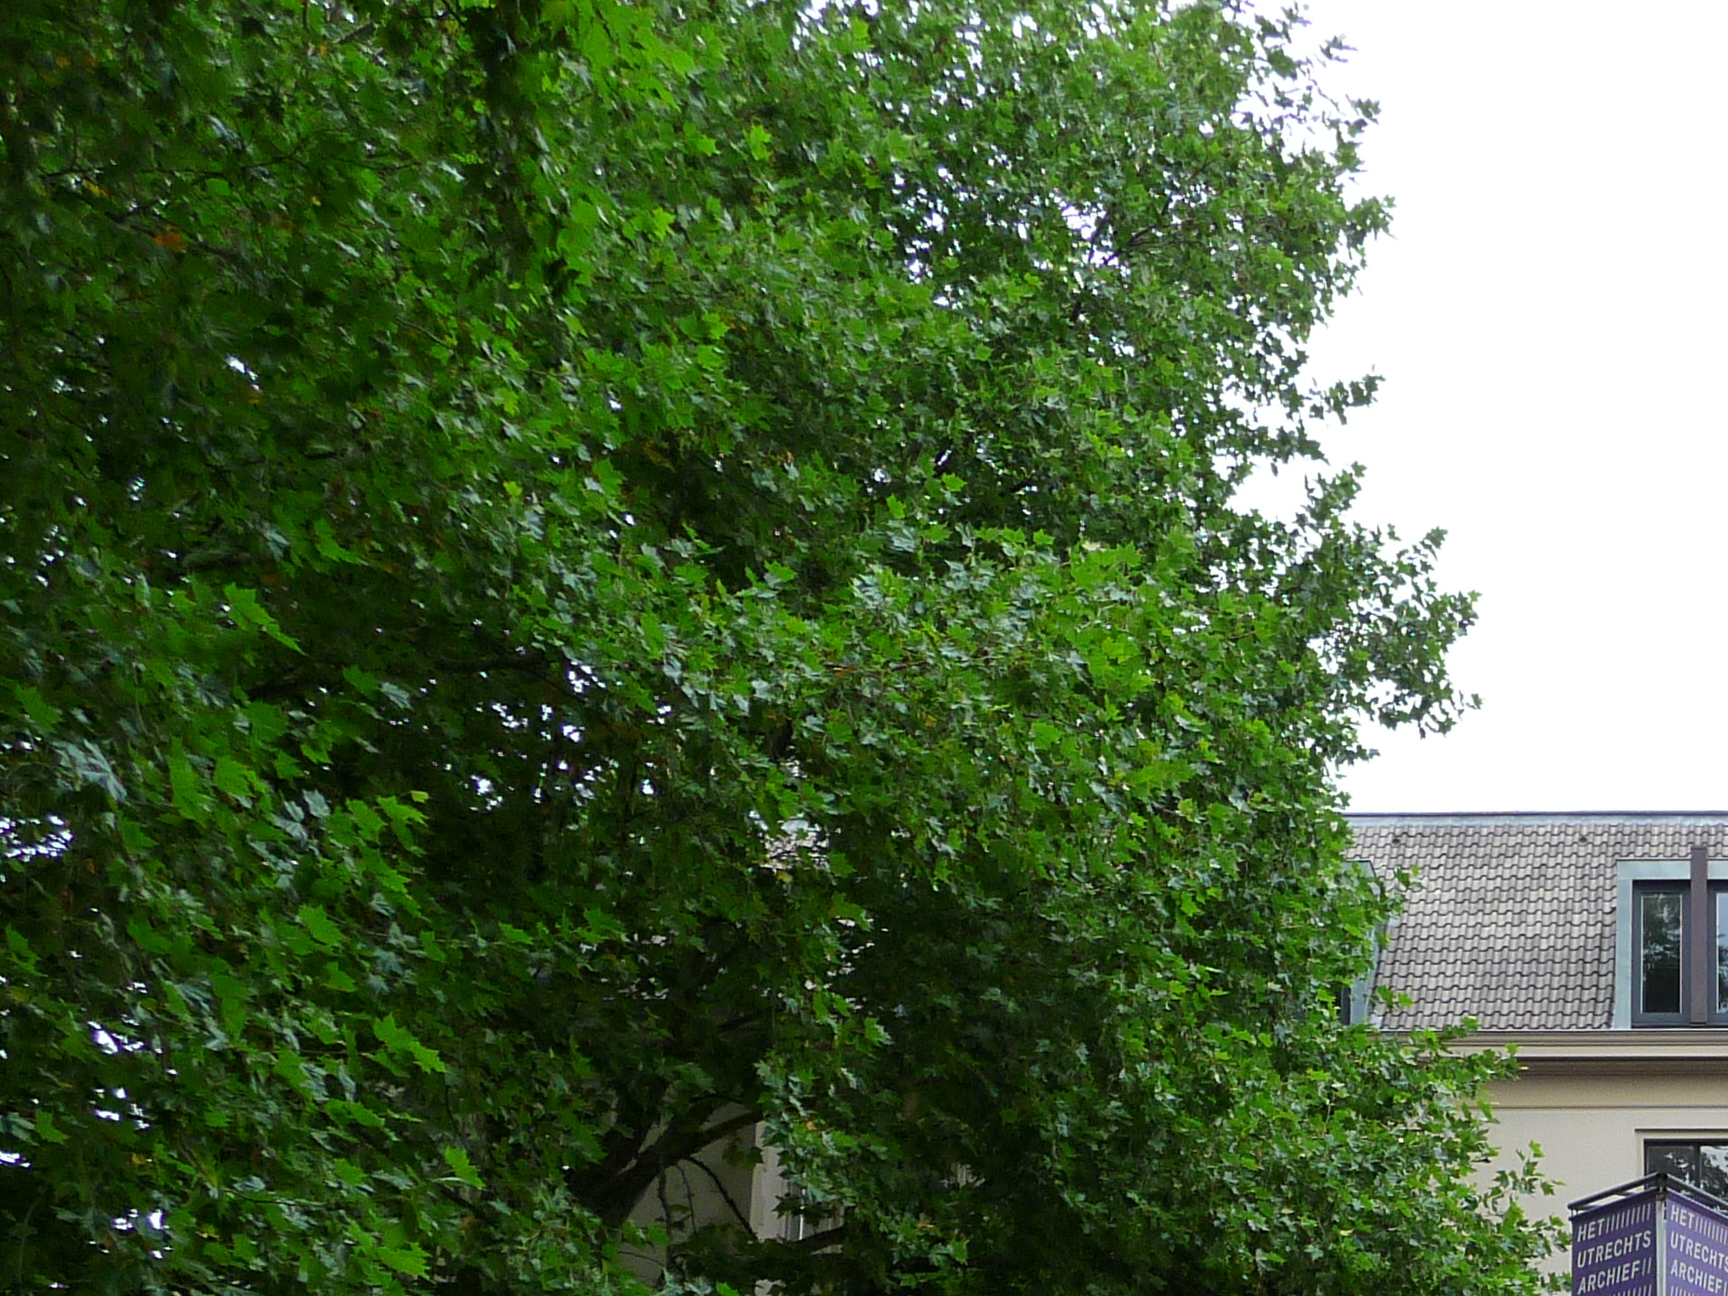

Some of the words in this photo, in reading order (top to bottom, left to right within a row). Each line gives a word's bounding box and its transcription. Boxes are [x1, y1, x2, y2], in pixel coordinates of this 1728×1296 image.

[1577, 1217, 1605, 1243] HET
[1670, 1206, 1695, 1229] HET
[1577, 1230, 1651, 1268] UTRECHTS
[1577, 1259, 1640, 1295] ARCHIEF
[1670, 1259, 1723, 1293] ARCHIEF
